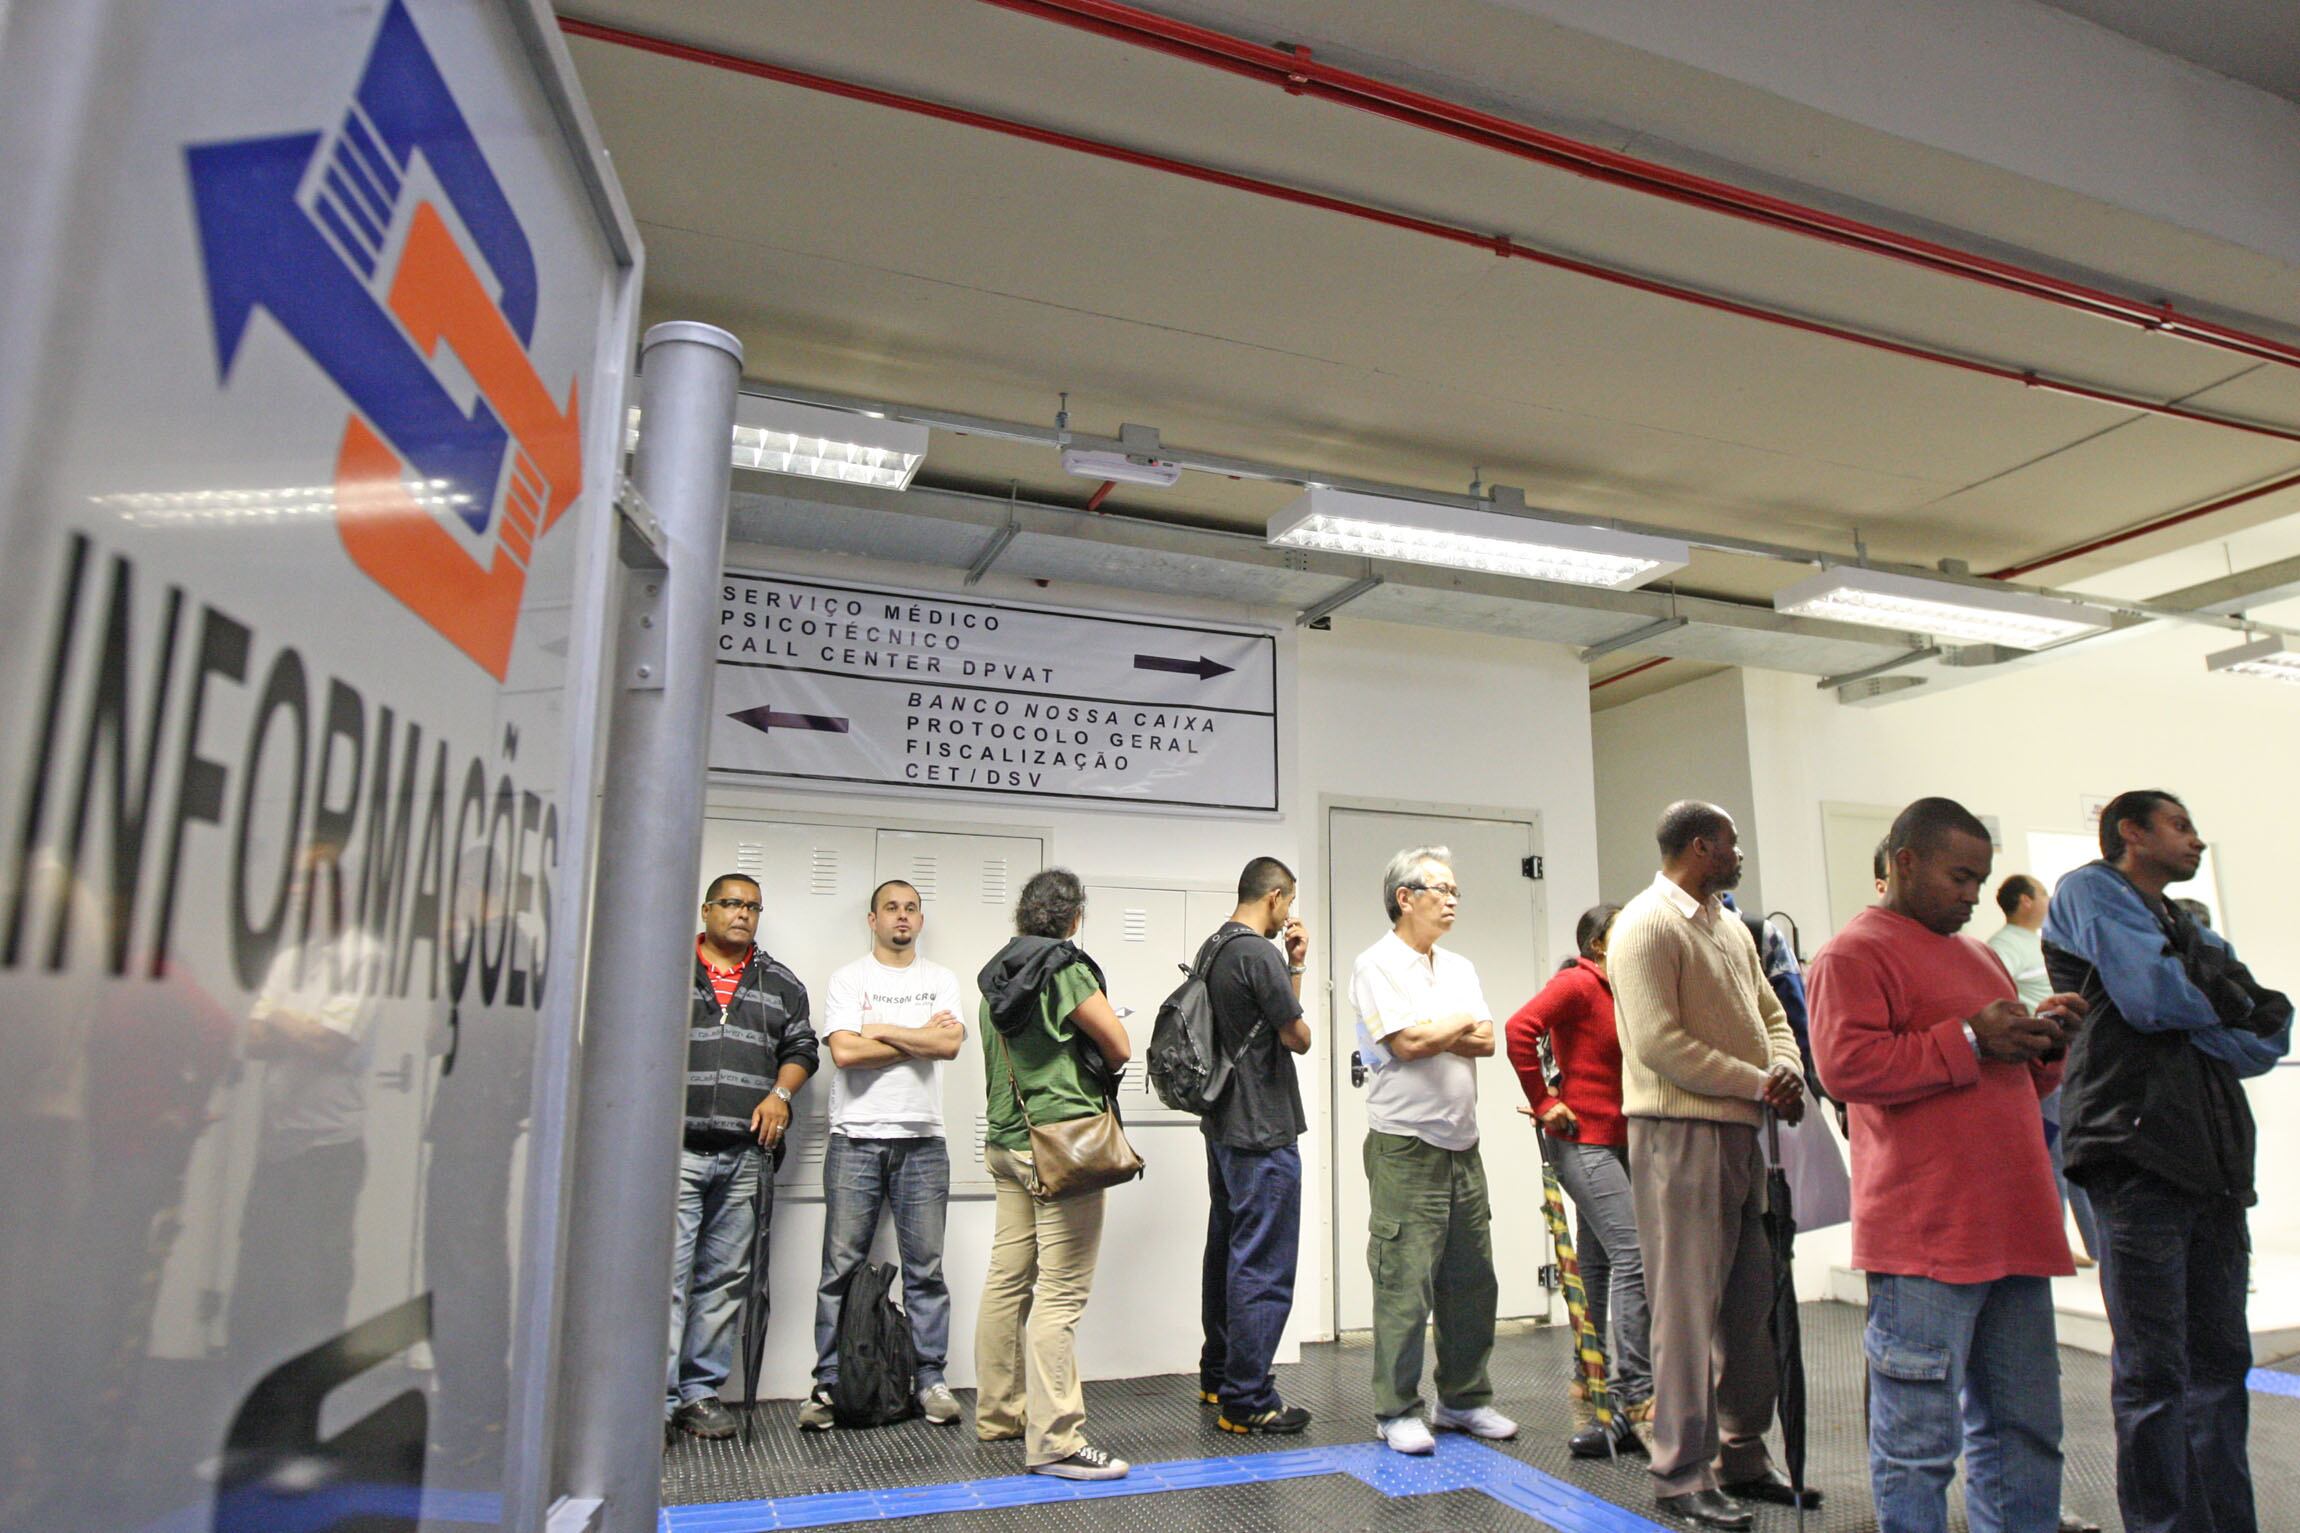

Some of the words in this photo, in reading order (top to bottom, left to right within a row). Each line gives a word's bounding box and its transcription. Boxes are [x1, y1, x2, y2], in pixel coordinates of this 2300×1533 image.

[723, 586, 862, 618] SERVIÇO
[885, 603, 1000, 632] MÉDICO
[721, 610, 961, 651] PSICOTÉCNICO
[719, 634, 799, 658] CALL
[820, 645, 941, 673] CENTER
[963, 660, 1054, 684] DPVAT
[907, 692, 1009, 716] BANCO
[1024, 702, 1119, 726] NOSSA
[1134, 712, 1215, 733] CAIXA
[907, 716, 1089, 746] PROTOCOLO
[1110, 733, 1199, 754] GERAL
[907, 740, 1129, 771] FISCALIZAÇÃO
[905, 763, 1042, 787] CET/DSV
[1, 531, 558, 1076] INFORMAÇÕES
